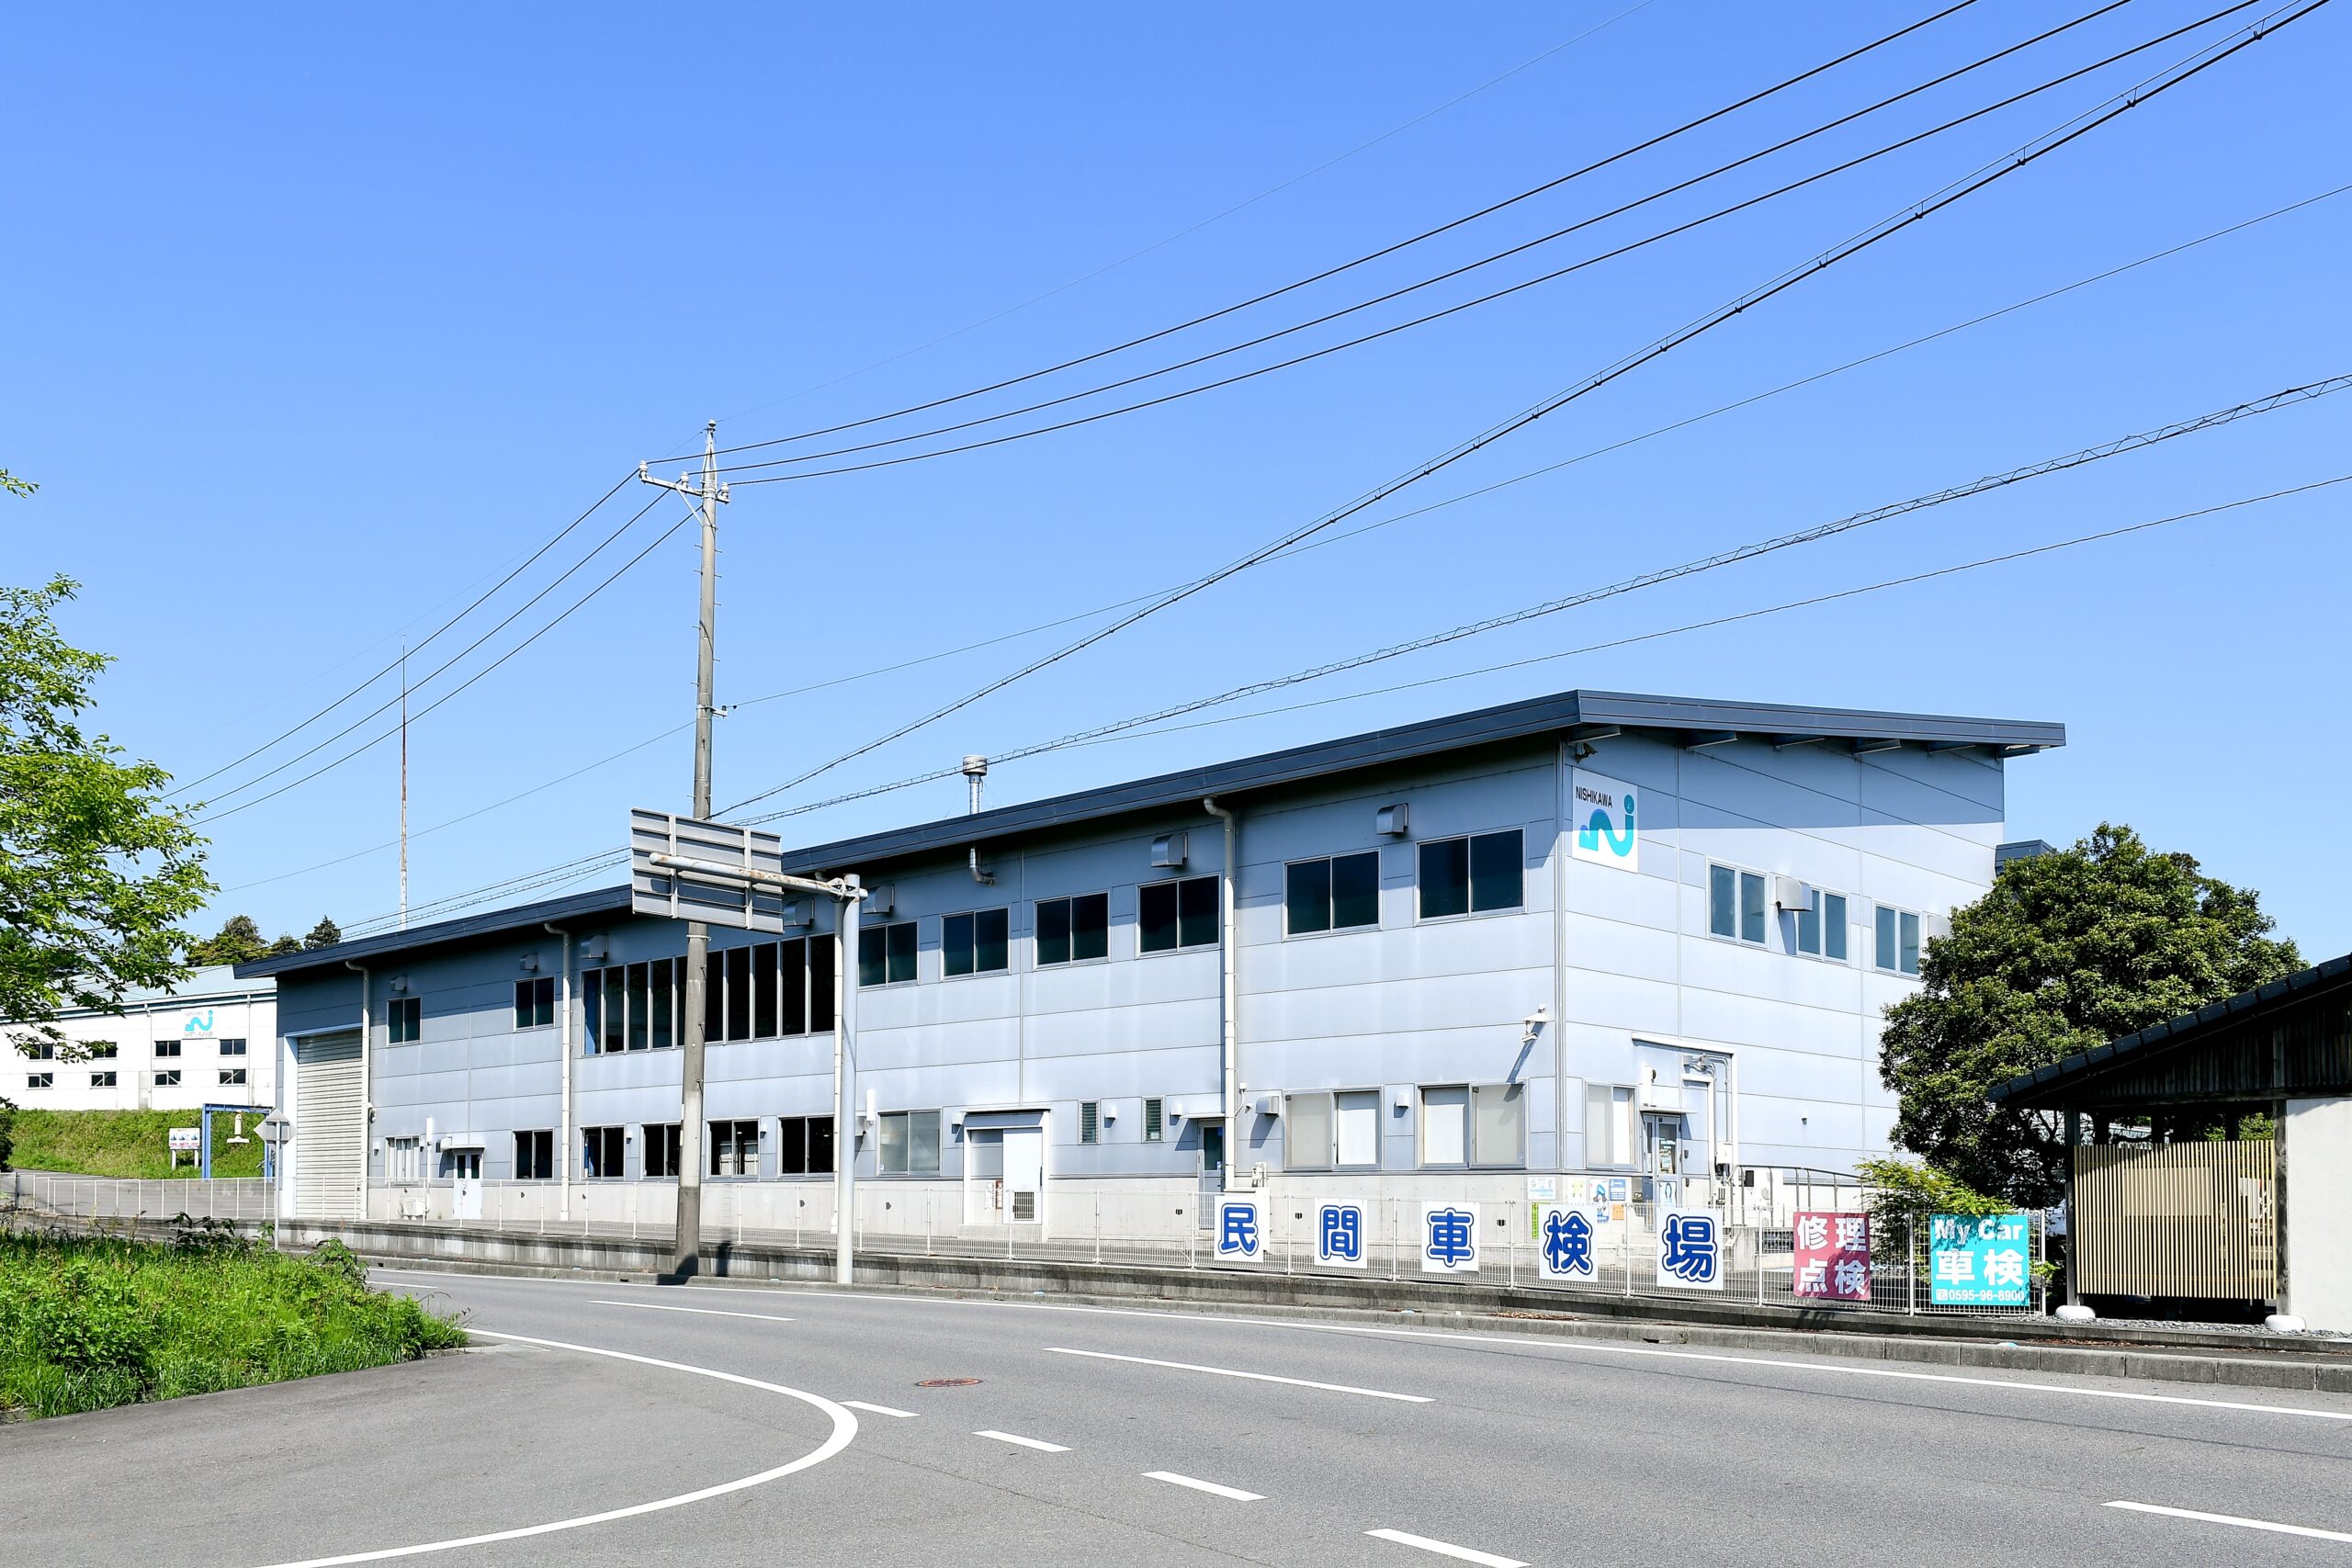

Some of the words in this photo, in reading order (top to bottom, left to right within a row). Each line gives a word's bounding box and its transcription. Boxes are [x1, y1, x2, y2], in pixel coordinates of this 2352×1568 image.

[1576, 785, 1612, 808] NISHIKAWA
[1218, 1202, 1259, 1256] 民
[1320, 1205, 1362, 1261] 間
[1428, 1207, 1474, 1267] 車
[1544, 1211, 1593, 1275] 検
[1662, 1213, 1717, 1282] 場
[1797, 1215, 1867, 1251] 修理
[1934, 1219, 1971, 1245] My
[1978, 1219, 2024, 1241] Car
[1798, 1258, 1867, 1295] 点検
[1936, 1248, 2024, 1286] 車検
[1949, 1289, 2025, 1302] 0595-96-8900
